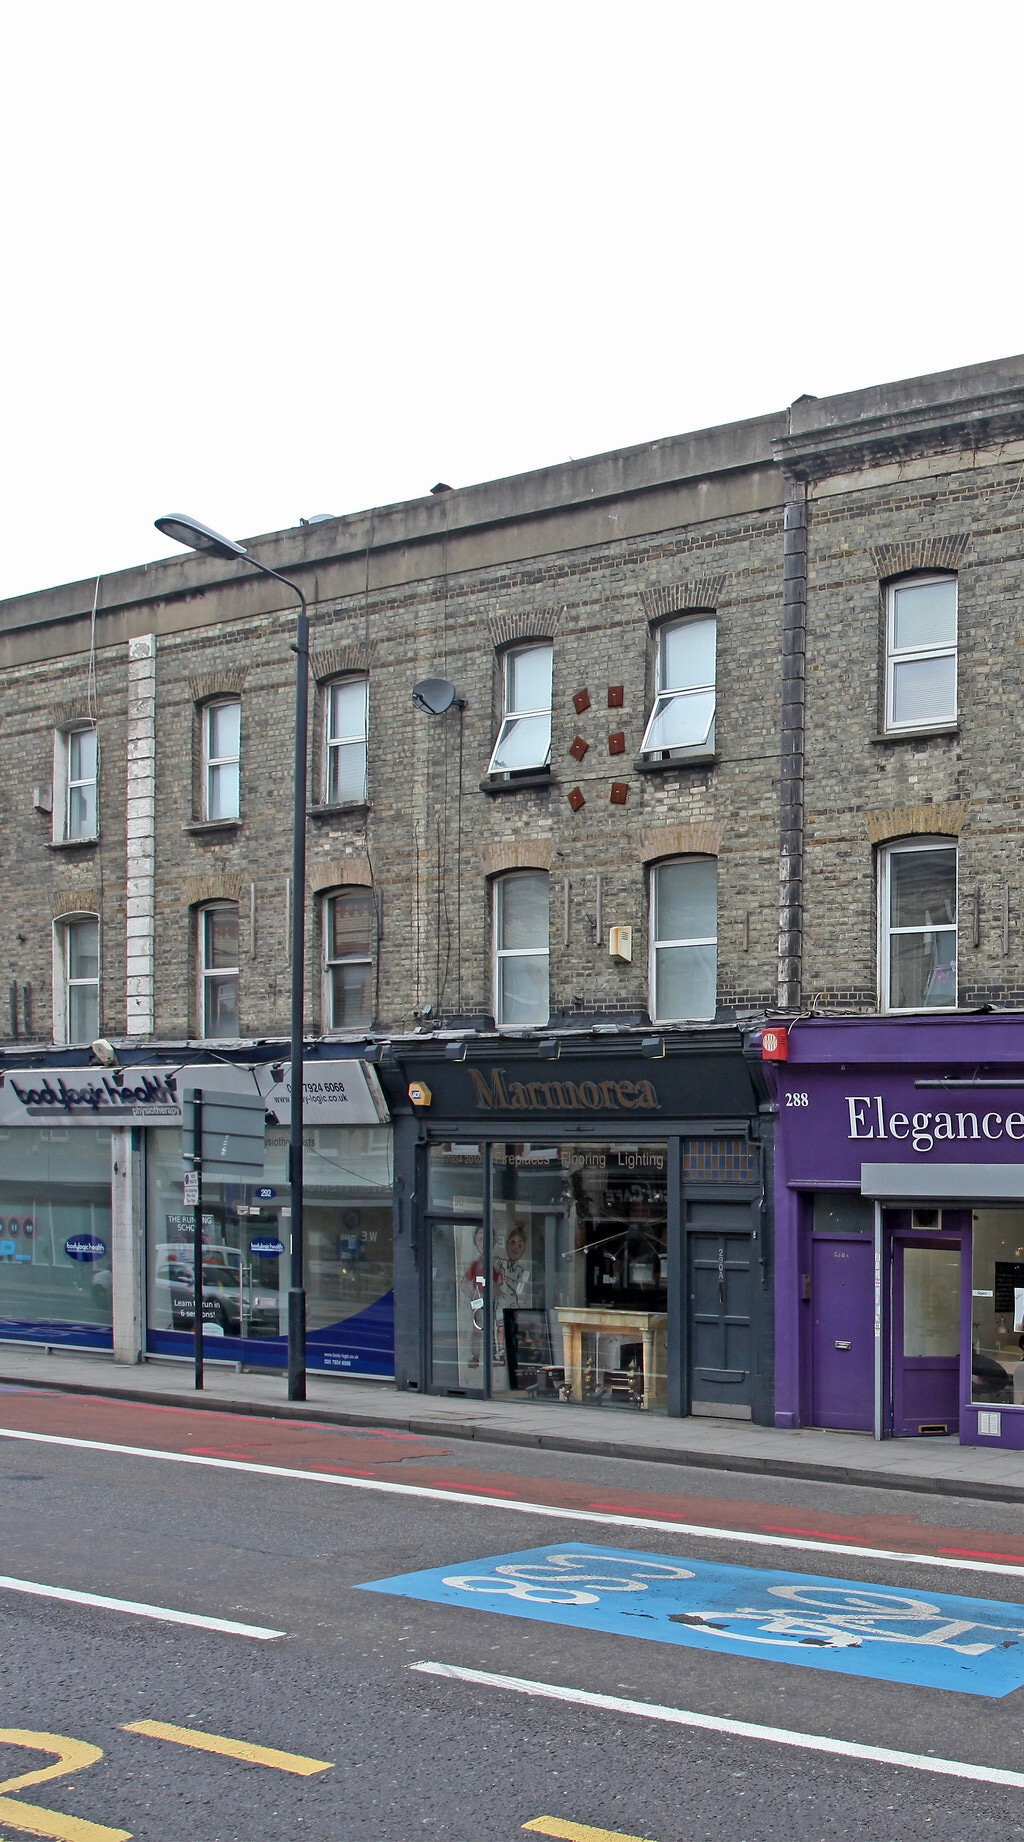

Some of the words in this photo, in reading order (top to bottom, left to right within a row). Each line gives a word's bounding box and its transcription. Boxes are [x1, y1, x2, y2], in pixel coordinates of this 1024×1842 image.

[325, 1082, 345, 1093] 6068
[467, 1068, 661, 1109] Marmorea
[785, 1093, 809, 1107] 288
[132, 1106, 180, 1116] physiotherapy
[494, 1153, 550, 1165] Fireplaces
[561, 1153, 606, 1168] Flooring
[618, 1153, 664, 1169] Lighting
[260, 1188, 271, 1197] 292
[168, 1215, 180, 1223] THE
[182, 1216, 212, 1224] RUNNG
[174, 1299, 194, 1307] Learn
